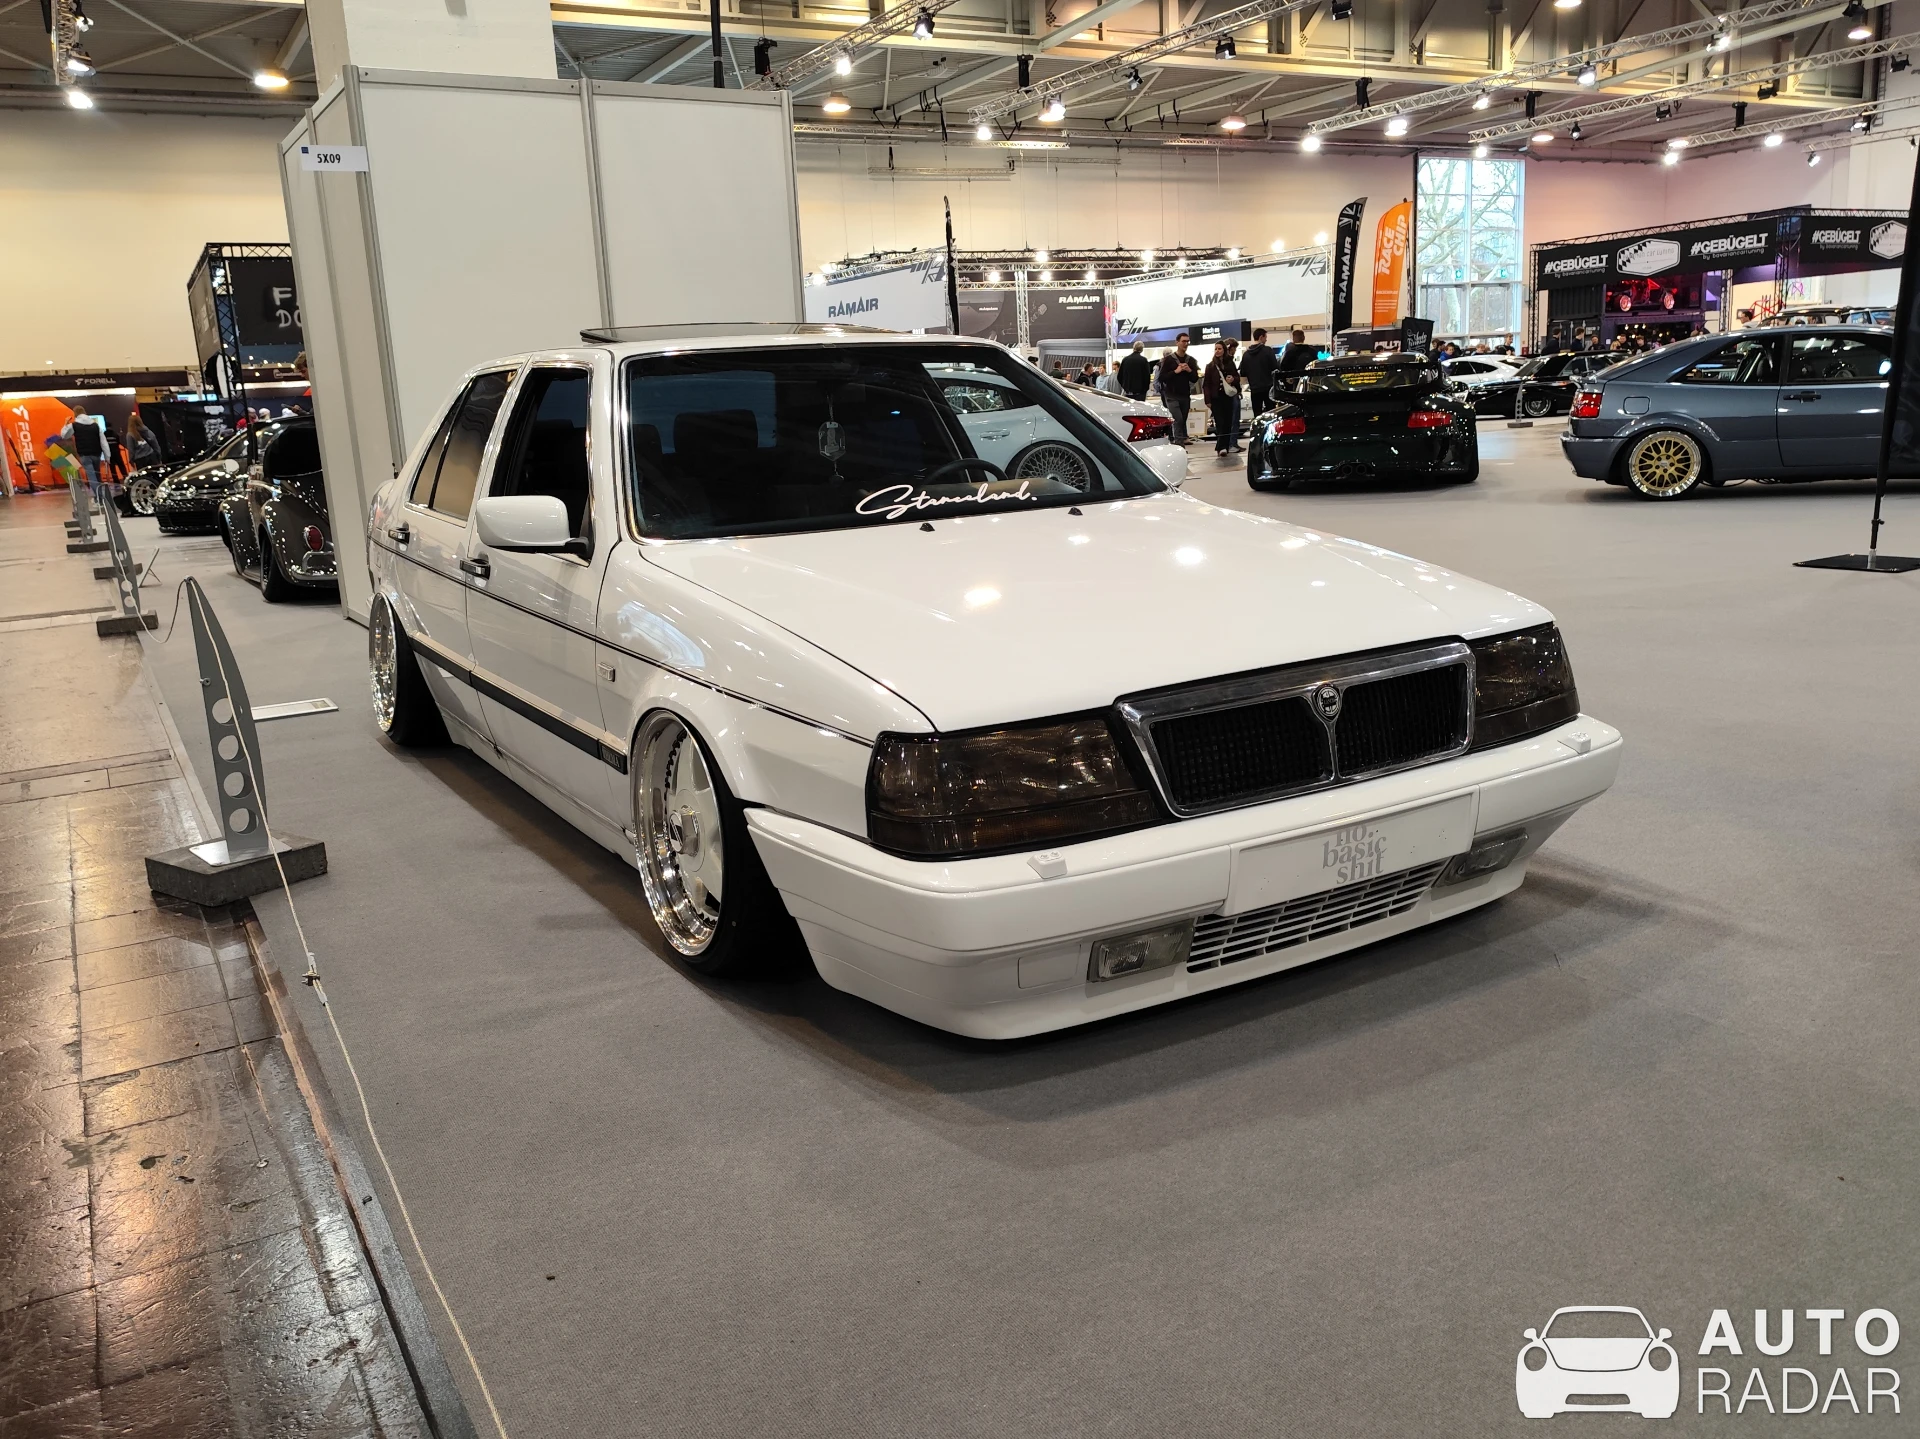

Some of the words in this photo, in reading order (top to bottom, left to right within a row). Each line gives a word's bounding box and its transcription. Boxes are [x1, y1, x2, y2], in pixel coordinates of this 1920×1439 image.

[316, 153, 341, 164] 5X09
[1393, 214, 1406, 257] CHIP
[1690, 232, 1769, 256] #GEBÜGELT
[1379, 226, 1395, 275] RACE
[1337, 236, 1352, 304] RAMAIR
[1544, 254, 1609, 274] #GEBÜGELT
[828, 295, 879, 318] RAMAIR
[1058, 293, 1100, 304] RAMAIR
[1182, 288, 1247, 308] RAMAIR
[1335, 824, 1374, 846] no.
[1323, 837, 1387, 869] basic
[1337, 850, 1381, 884] shit
